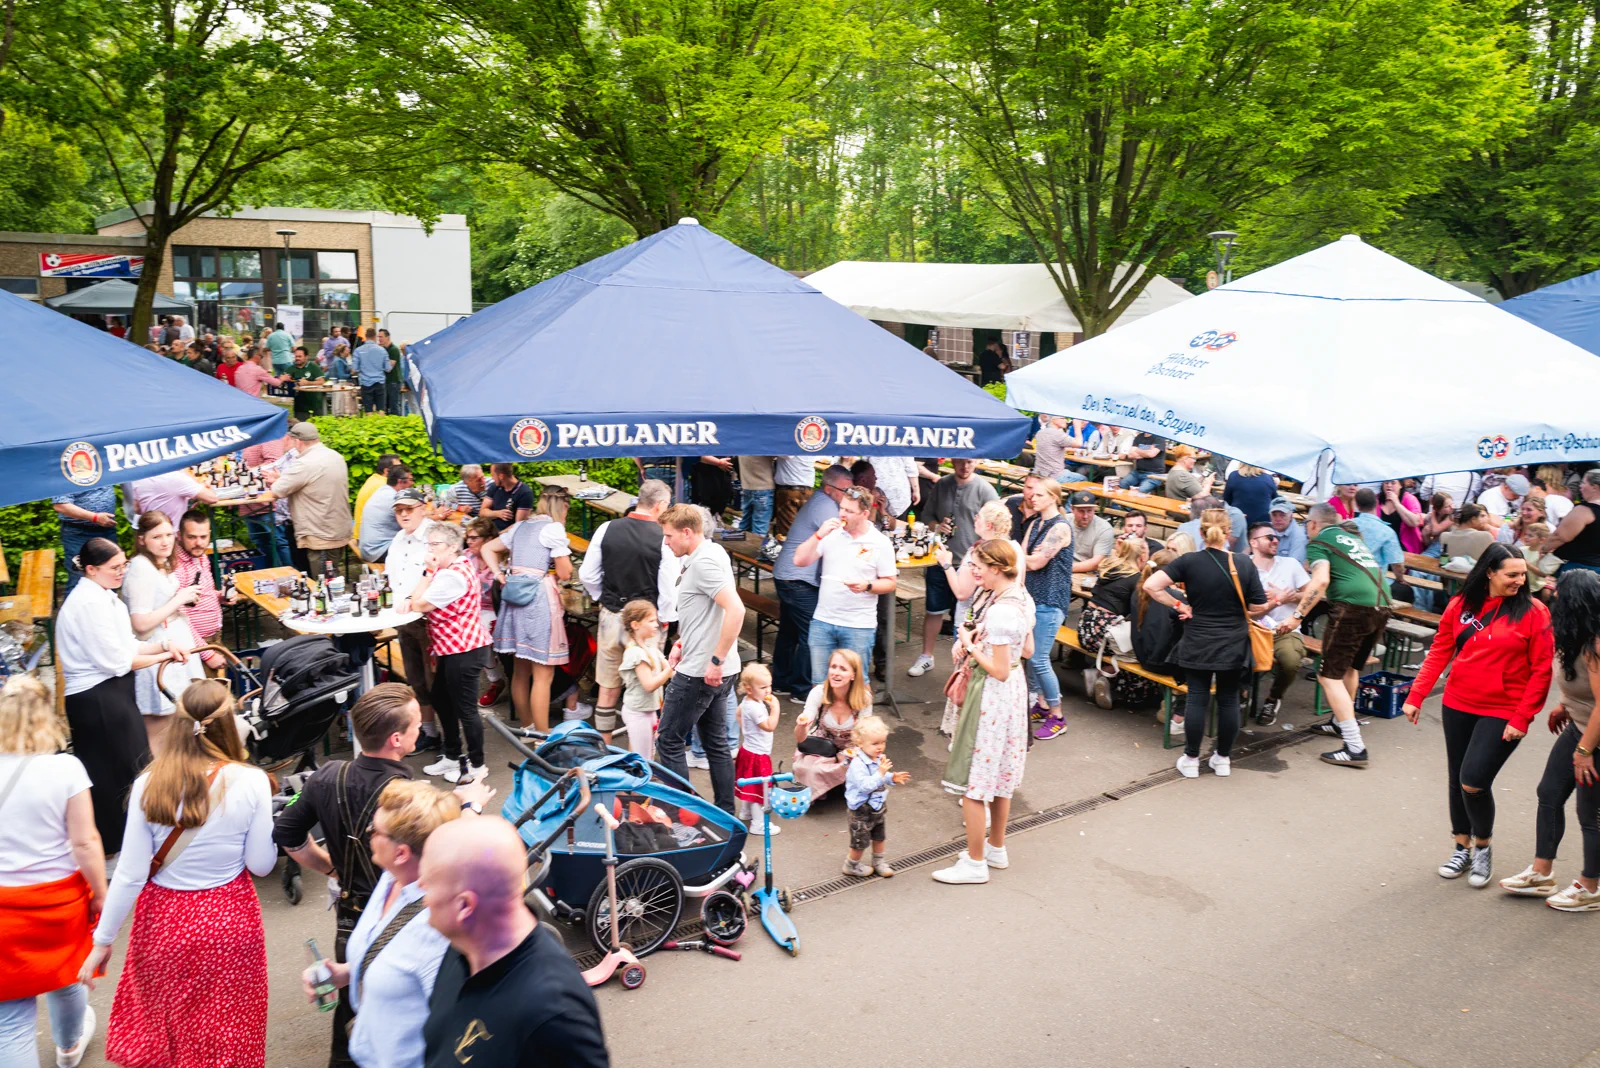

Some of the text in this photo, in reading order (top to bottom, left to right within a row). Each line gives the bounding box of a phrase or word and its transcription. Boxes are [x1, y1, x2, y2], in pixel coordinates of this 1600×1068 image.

[1082, 394, 1100, 411] Der
[1140, 407, 1156, 423] der
[1158, 410, 1207, 437] Bayern
[103, 425, 252, 472] PAULANER
[556, 421, 721, 448] PAULANER
[835, 422, 976, 449] PAULANER
